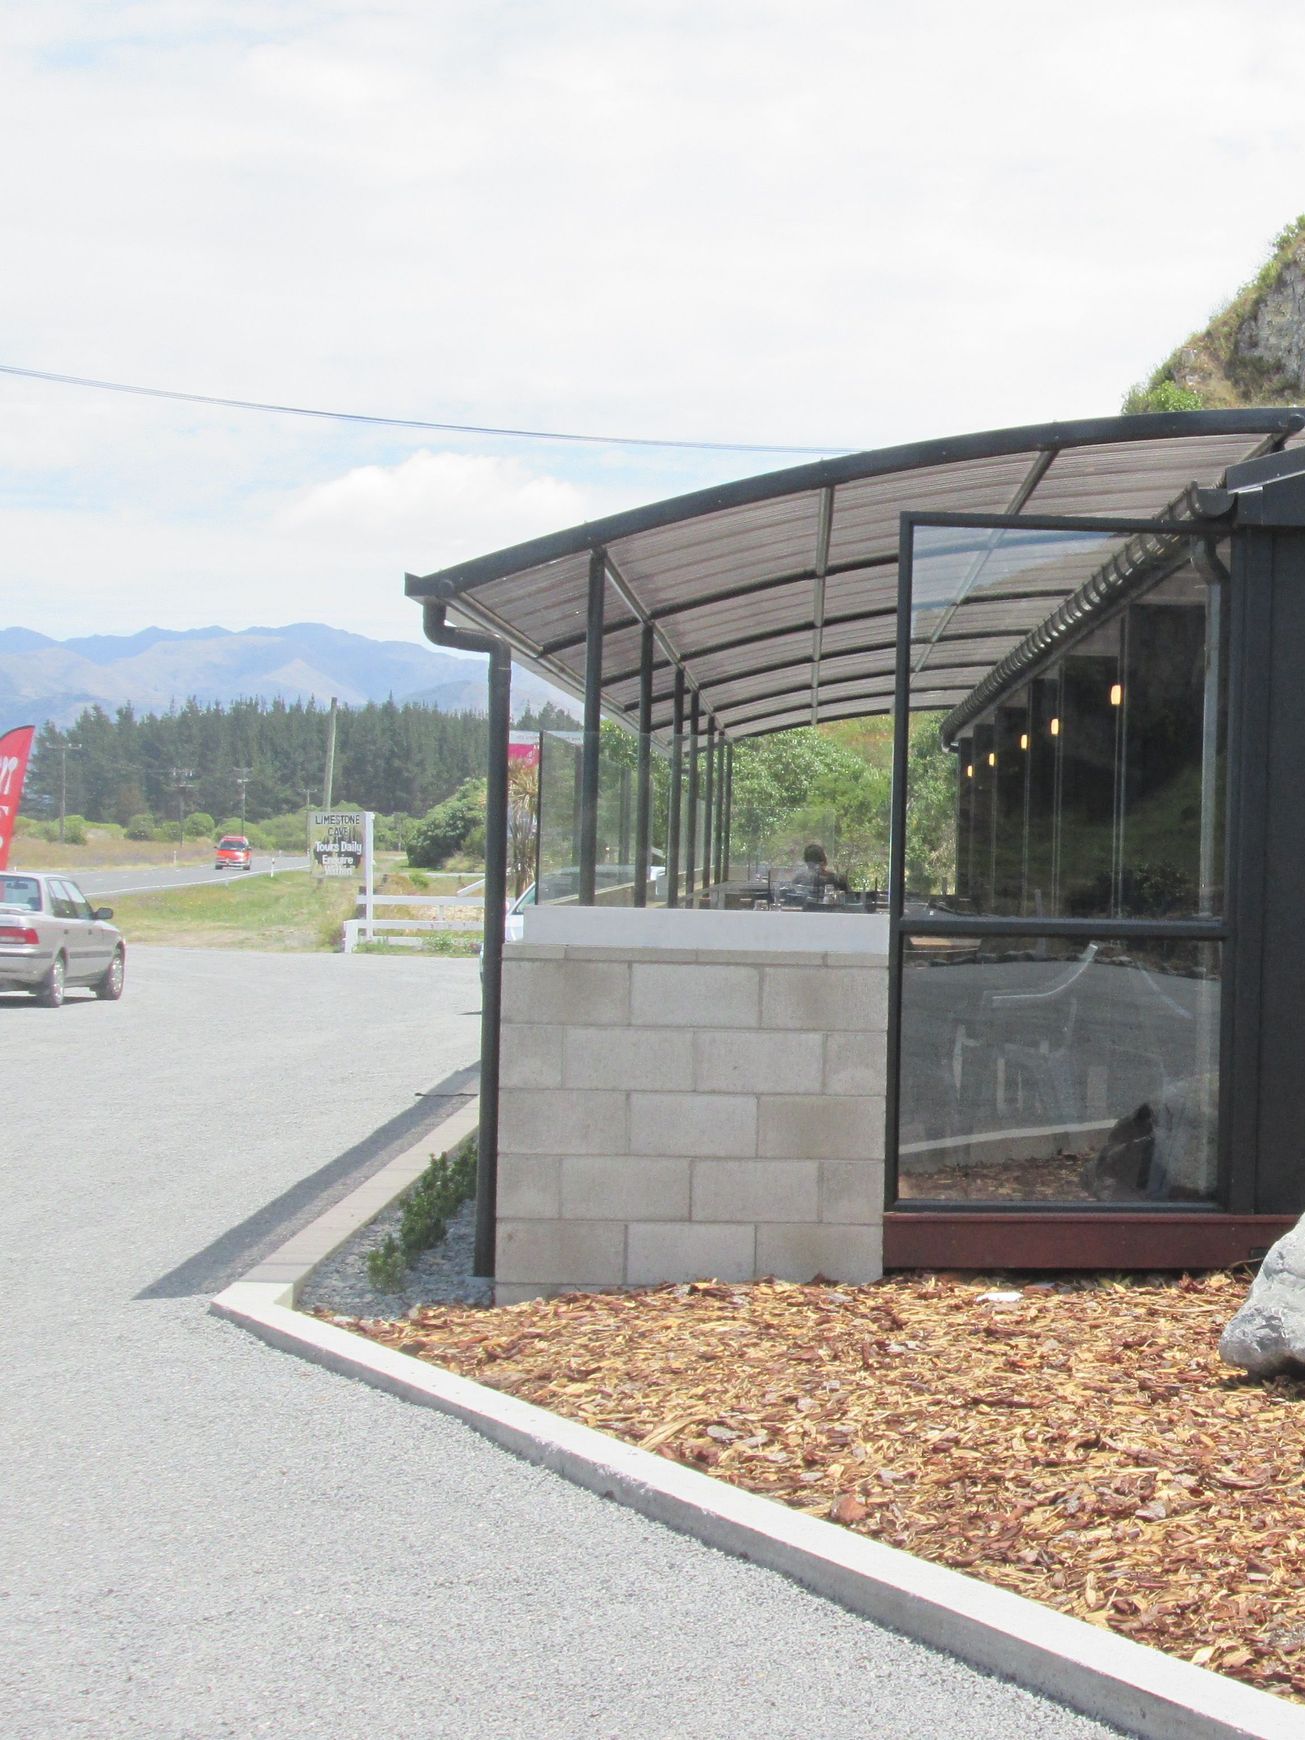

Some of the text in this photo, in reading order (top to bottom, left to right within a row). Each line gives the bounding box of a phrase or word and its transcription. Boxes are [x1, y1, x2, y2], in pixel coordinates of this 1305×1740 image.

[315, 814, 360, 825] LIMESTONE
[328, 826, 350, 837] CAVE
[315, 841, 362, 855] Tours Daily
